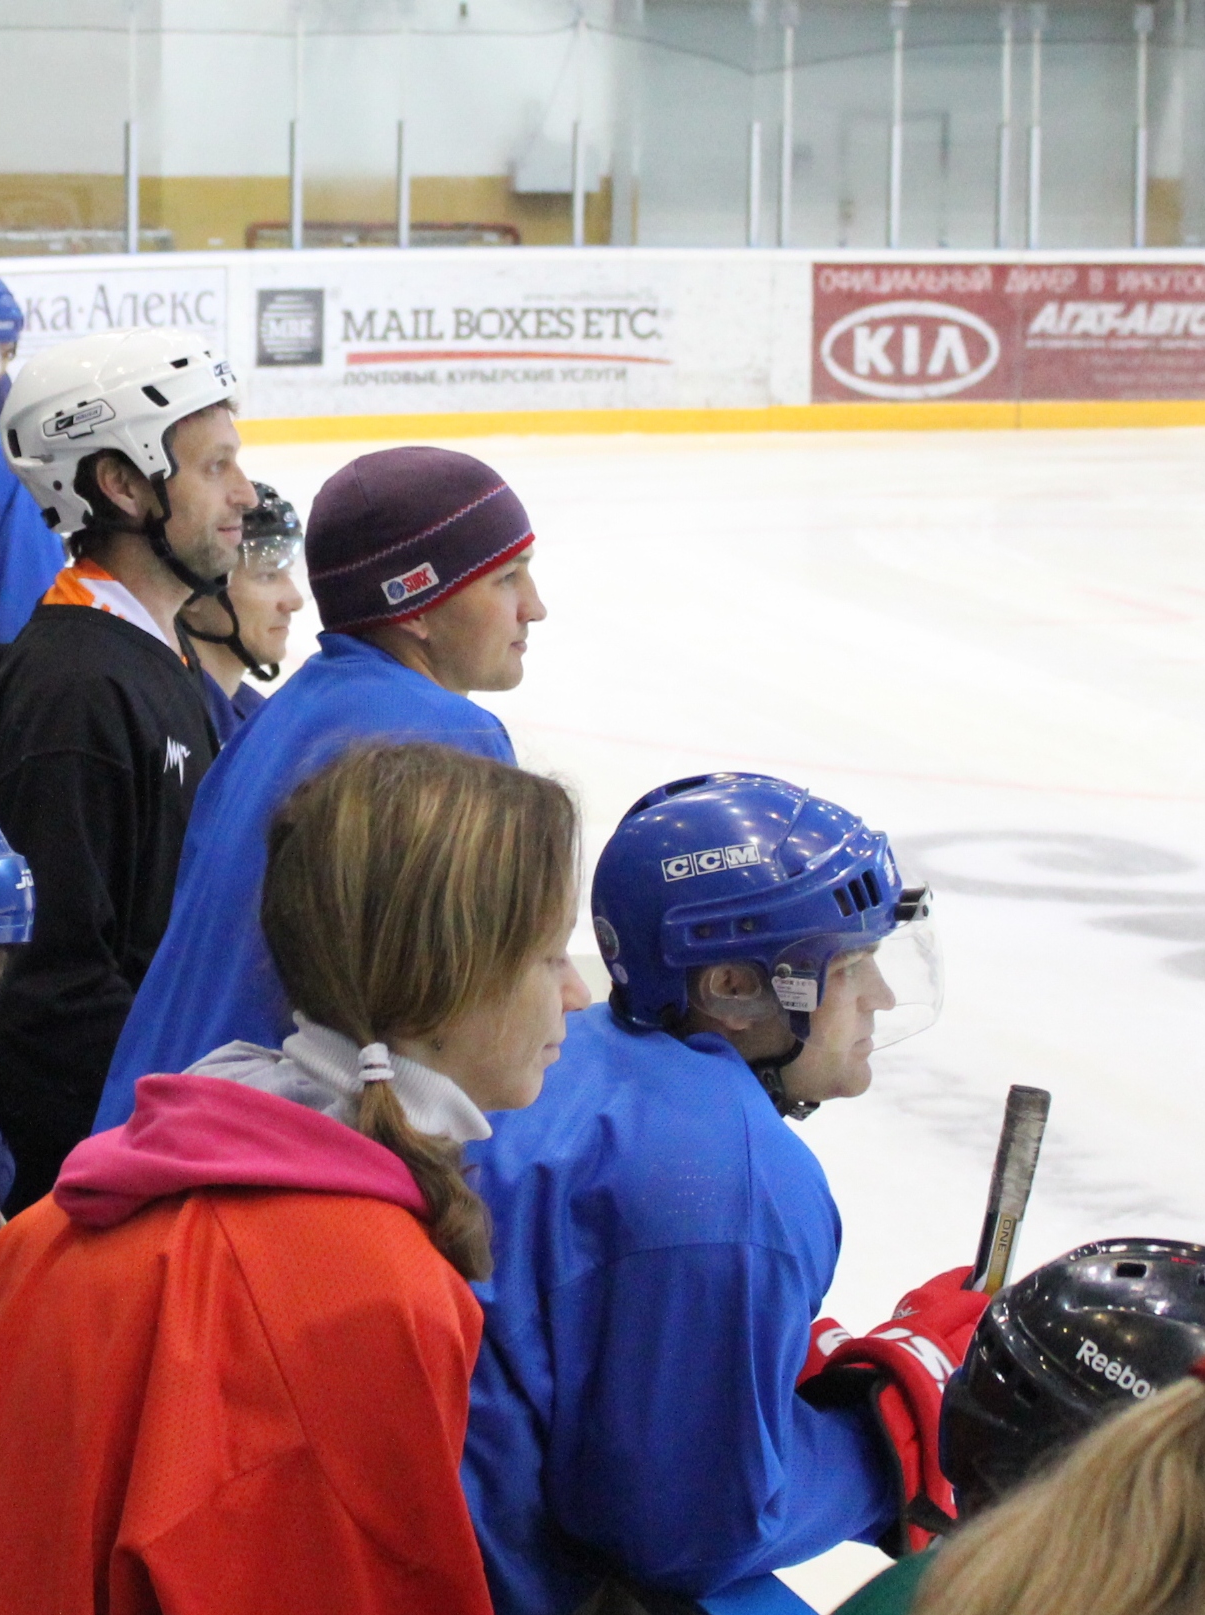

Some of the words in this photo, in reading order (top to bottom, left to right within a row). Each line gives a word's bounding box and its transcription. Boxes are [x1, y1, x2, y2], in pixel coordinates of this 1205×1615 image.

[342, 307, 444, 342] MAIL
[453, 306, 575, 341] BOXES
[582, 306, 662, 340] ETC.
[853, 324, 971, 377] KIA
[664, 845, 759, 879] CCM
[1075, 1338, 1156, 1400] Reebo
